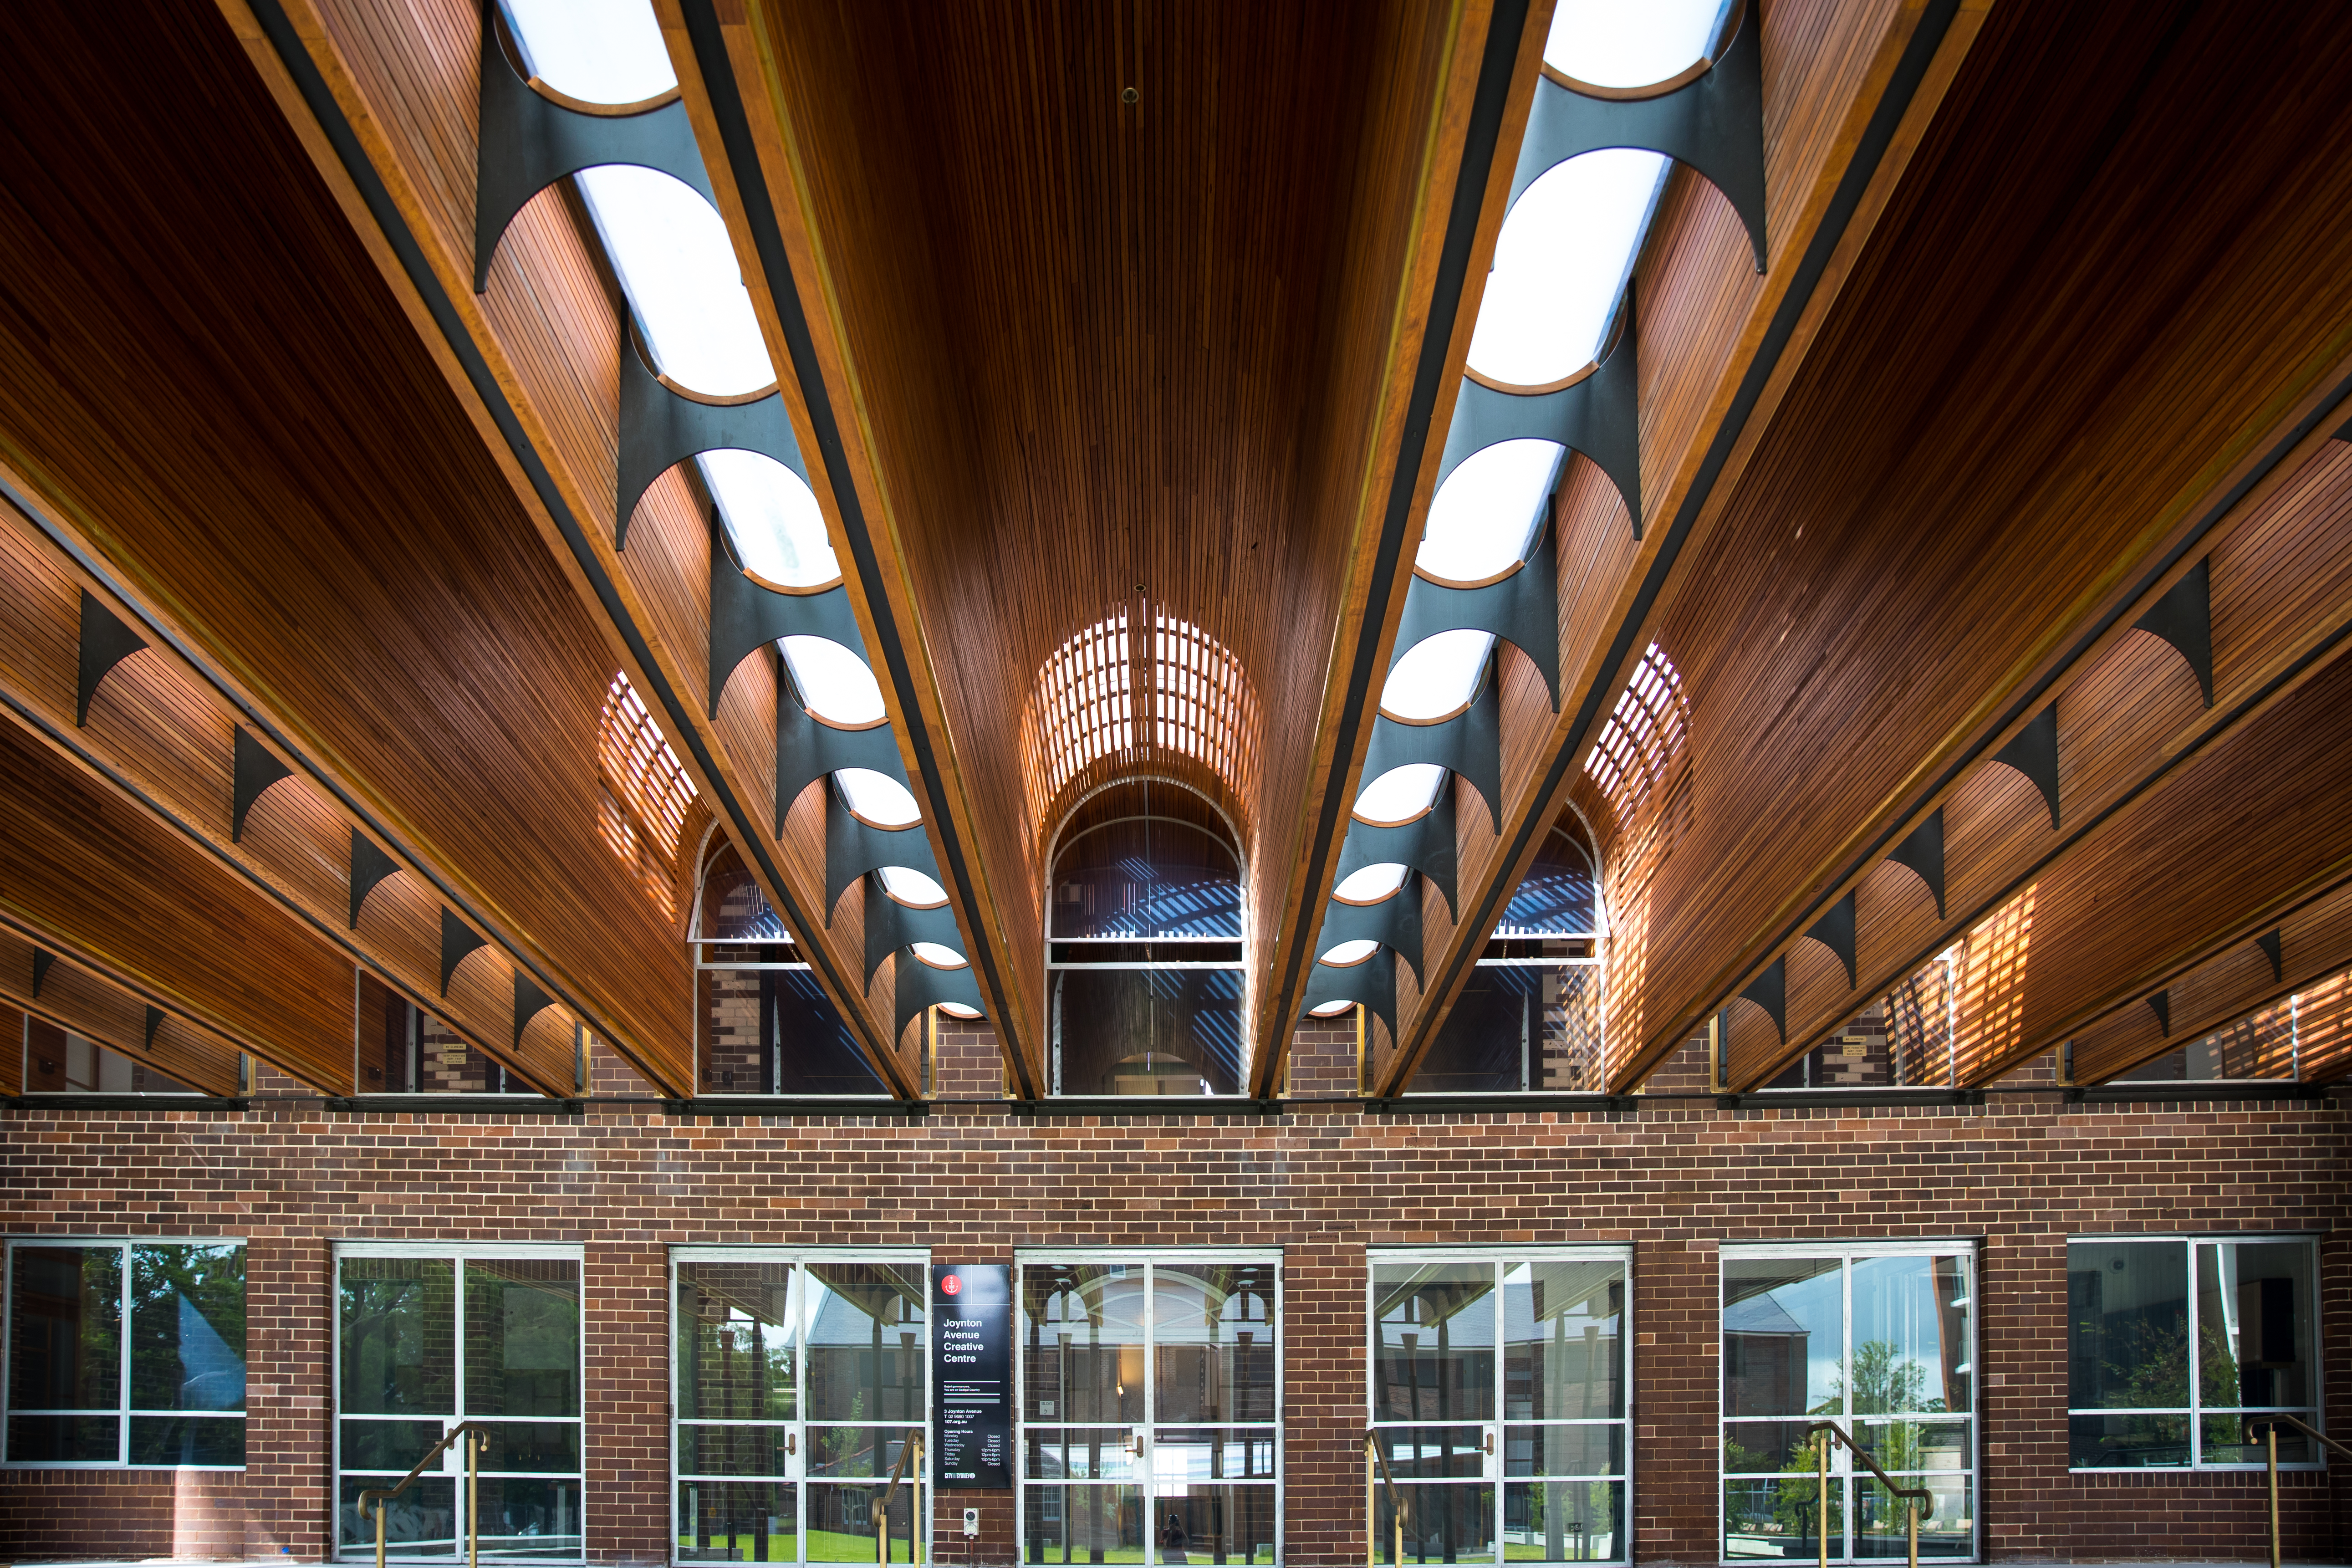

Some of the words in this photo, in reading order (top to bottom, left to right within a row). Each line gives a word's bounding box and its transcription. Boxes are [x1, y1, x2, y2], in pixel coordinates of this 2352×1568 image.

[943, 1318, 982, 1329] Joynton
[943, 1330, 980, 1339] Avenue
[944, 1342, 984, 1351] Creative
[944, 1354, 976, 1363] Centre
